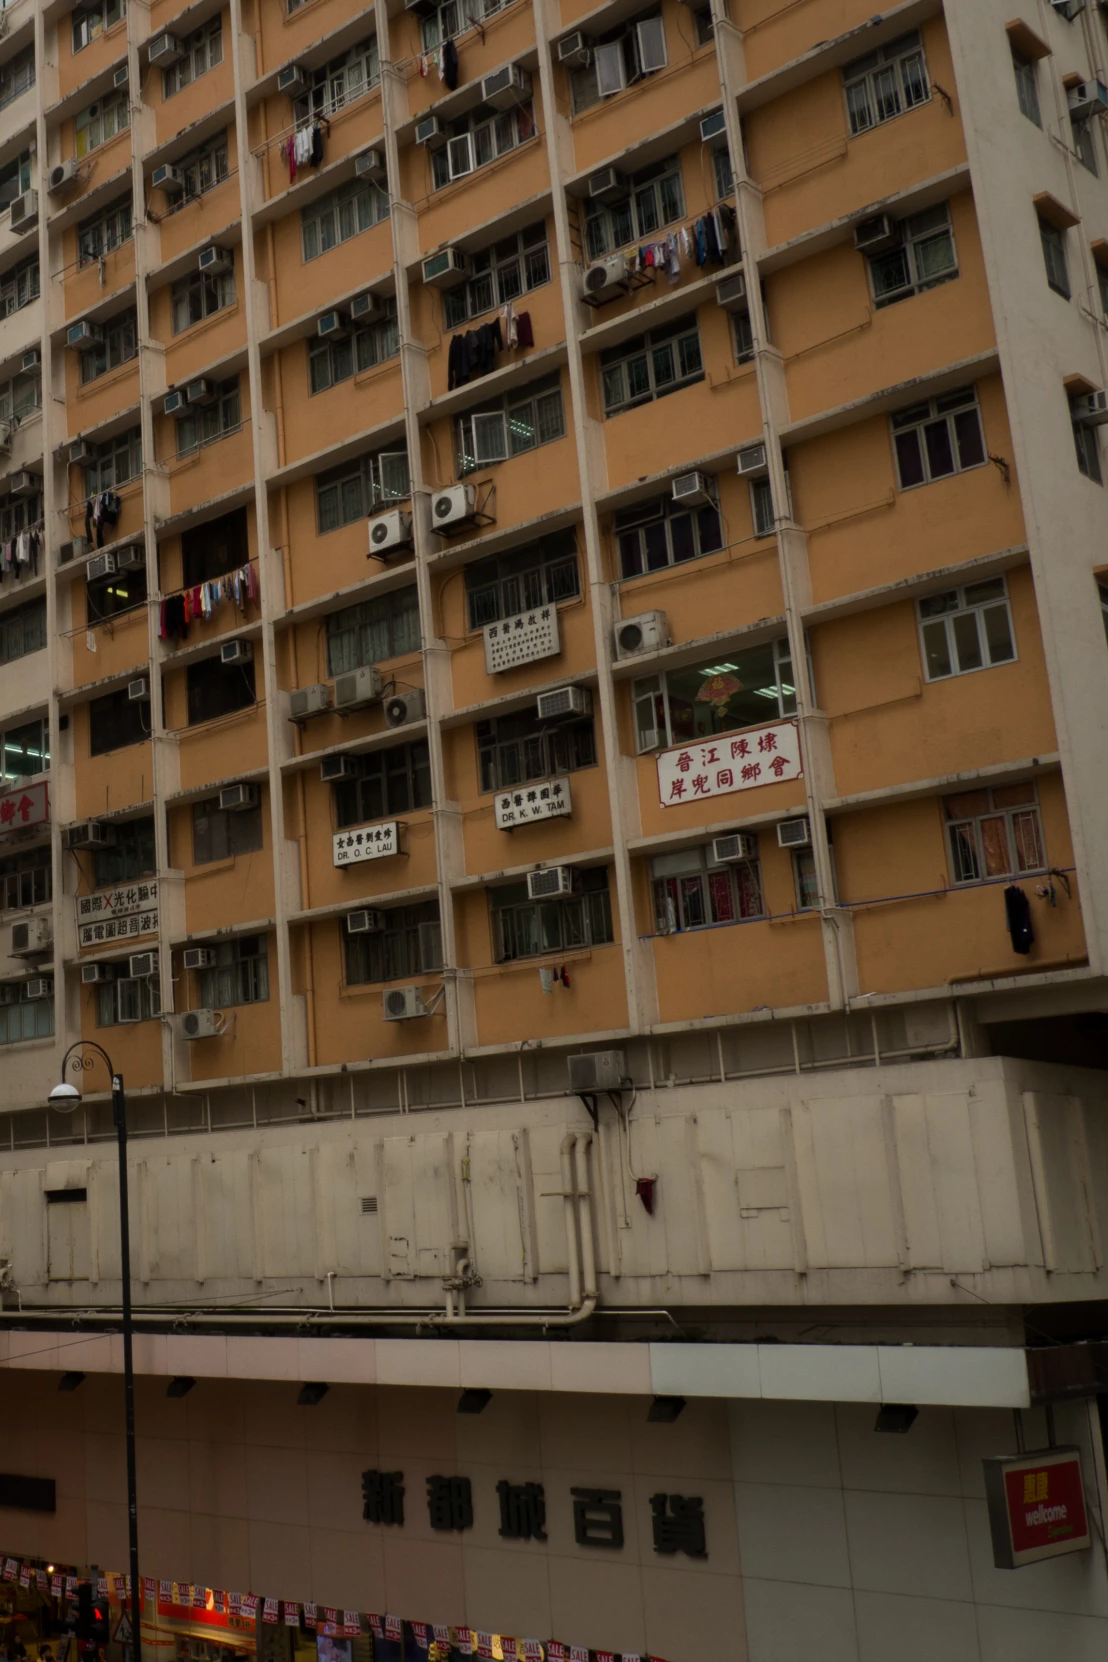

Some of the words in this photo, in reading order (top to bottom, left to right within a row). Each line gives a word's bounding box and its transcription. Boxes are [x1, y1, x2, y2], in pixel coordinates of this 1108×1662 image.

[676, 732, 778, 773] 晉江陳埭
[670, 755, 791, 800] 岸兜同鄉會
[502, 812, 516, 822] DR.
[519, 809, 528, 818] K.
[532, 806, 542, 815] W.
[546, 799, 565, 812] TAM
[338, 851, 350, 860] DR.
[354, 849, 362, 857] O.
[365, 847, 372, 855] C.
[377, 842, 392, 852] LAU
[1023, 1472, 1049, 1504] 惠康
[361, 1469, 709, 1560] 新都城百貨
[1025, 1504, 1068, 1527] wellcome
[144, 1578, 155, 1588] SALE
[244, 1595, 258, 1607] SALE
[265, 1600, 278, 1611] SALE
[285, 1604, 297, 1614] SALE
[304, 1604, 316, 1616] SALE
[345, 1613, 359, 1625] SALE
[368, 1615, 381, 1626] SALE
[386, 1617, 401, 1630] SALE
[412, 1623, 426, 1635] SALE
[433, 1627, 449, 1639] SALE
[456, 1629, 471, 1641] SALE
[477, 1634, 492, 1648] SALE
[501, 1639, 516, 1652] SALE
[524, 1641, 540, 1655] SALE
[548, 1643, 564, 1656] SALE
[571, 1649, 587, 1662] SALE
